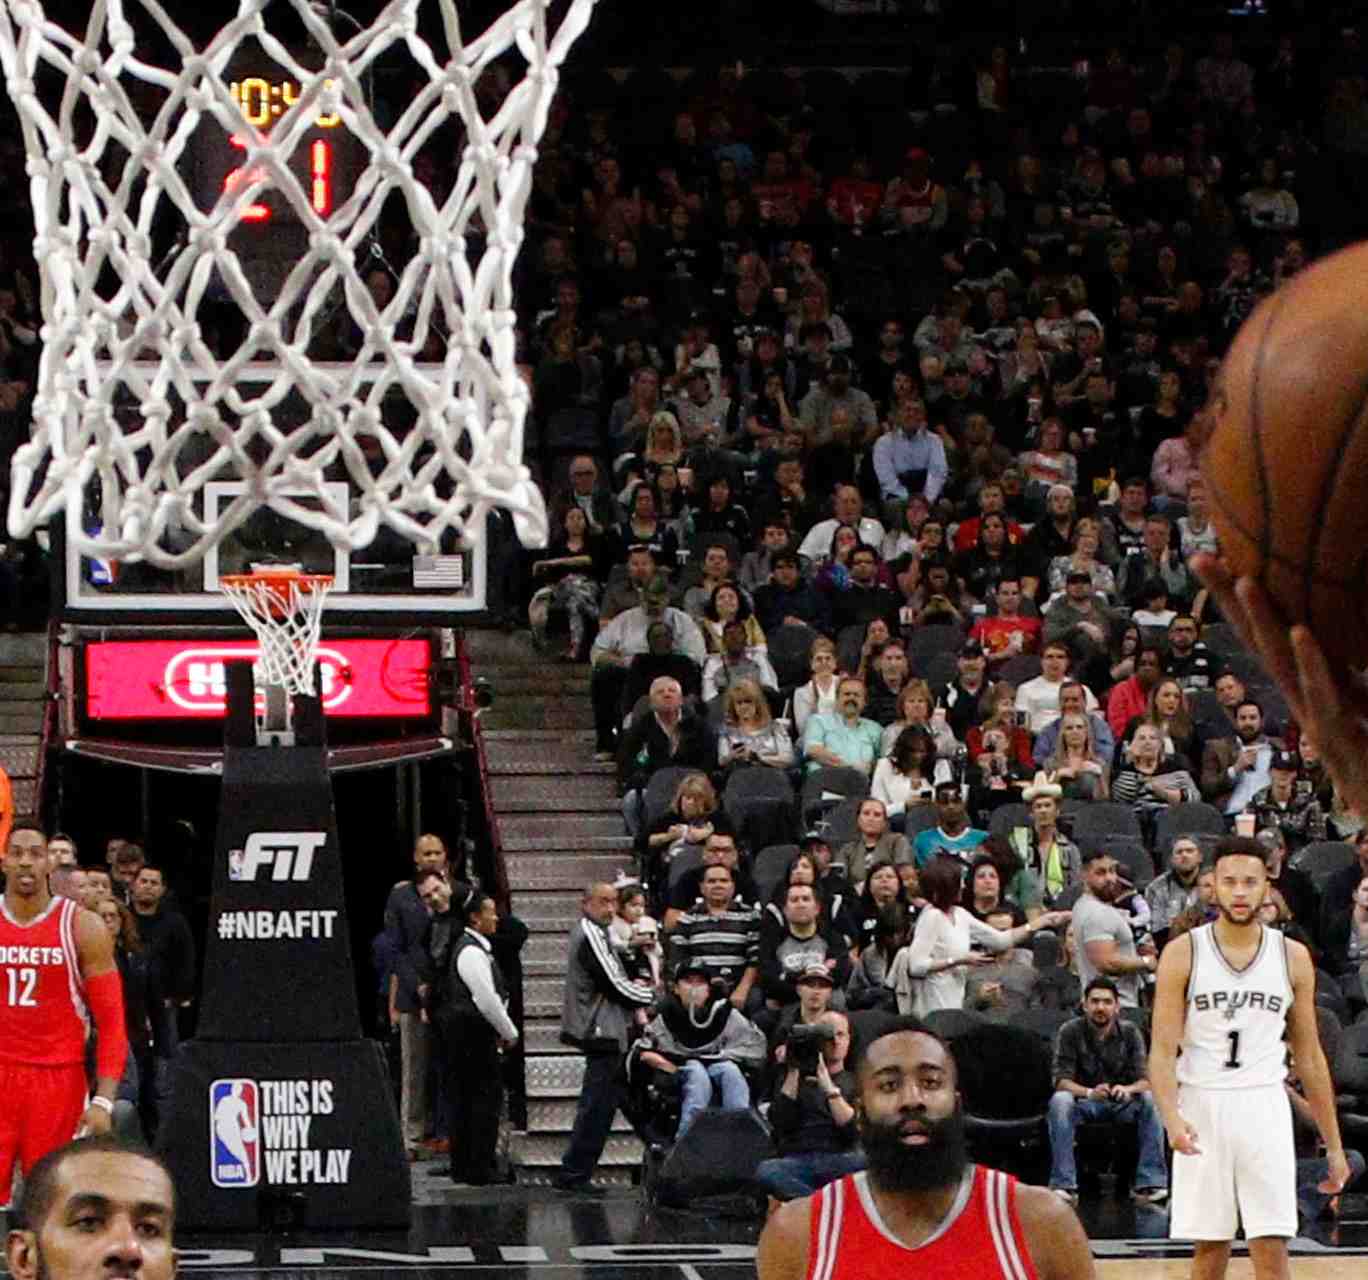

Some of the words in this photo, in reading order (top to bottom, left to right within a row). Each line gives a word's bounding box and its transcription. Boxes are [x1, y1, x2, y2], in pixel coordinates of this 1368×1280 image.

[236, 832, 328, 881] FIT
[217, 910, 338, 940] #NBAFIT
[0, 945, 64, 966] OCKETS
[5, 967, 37, 1007] 12
[1194, 990, 1282, 1020] SPURS
[1223, 1029, 1242, 1069] 1
[260, 1080, 310, 1115] THIS
[312, 1079, 334, 1115] IS
[262, 1115, 312, 1149] WHY
[264, 1150, 298, 1185] WE
[300, 1149, 352, 1184] PLAY
